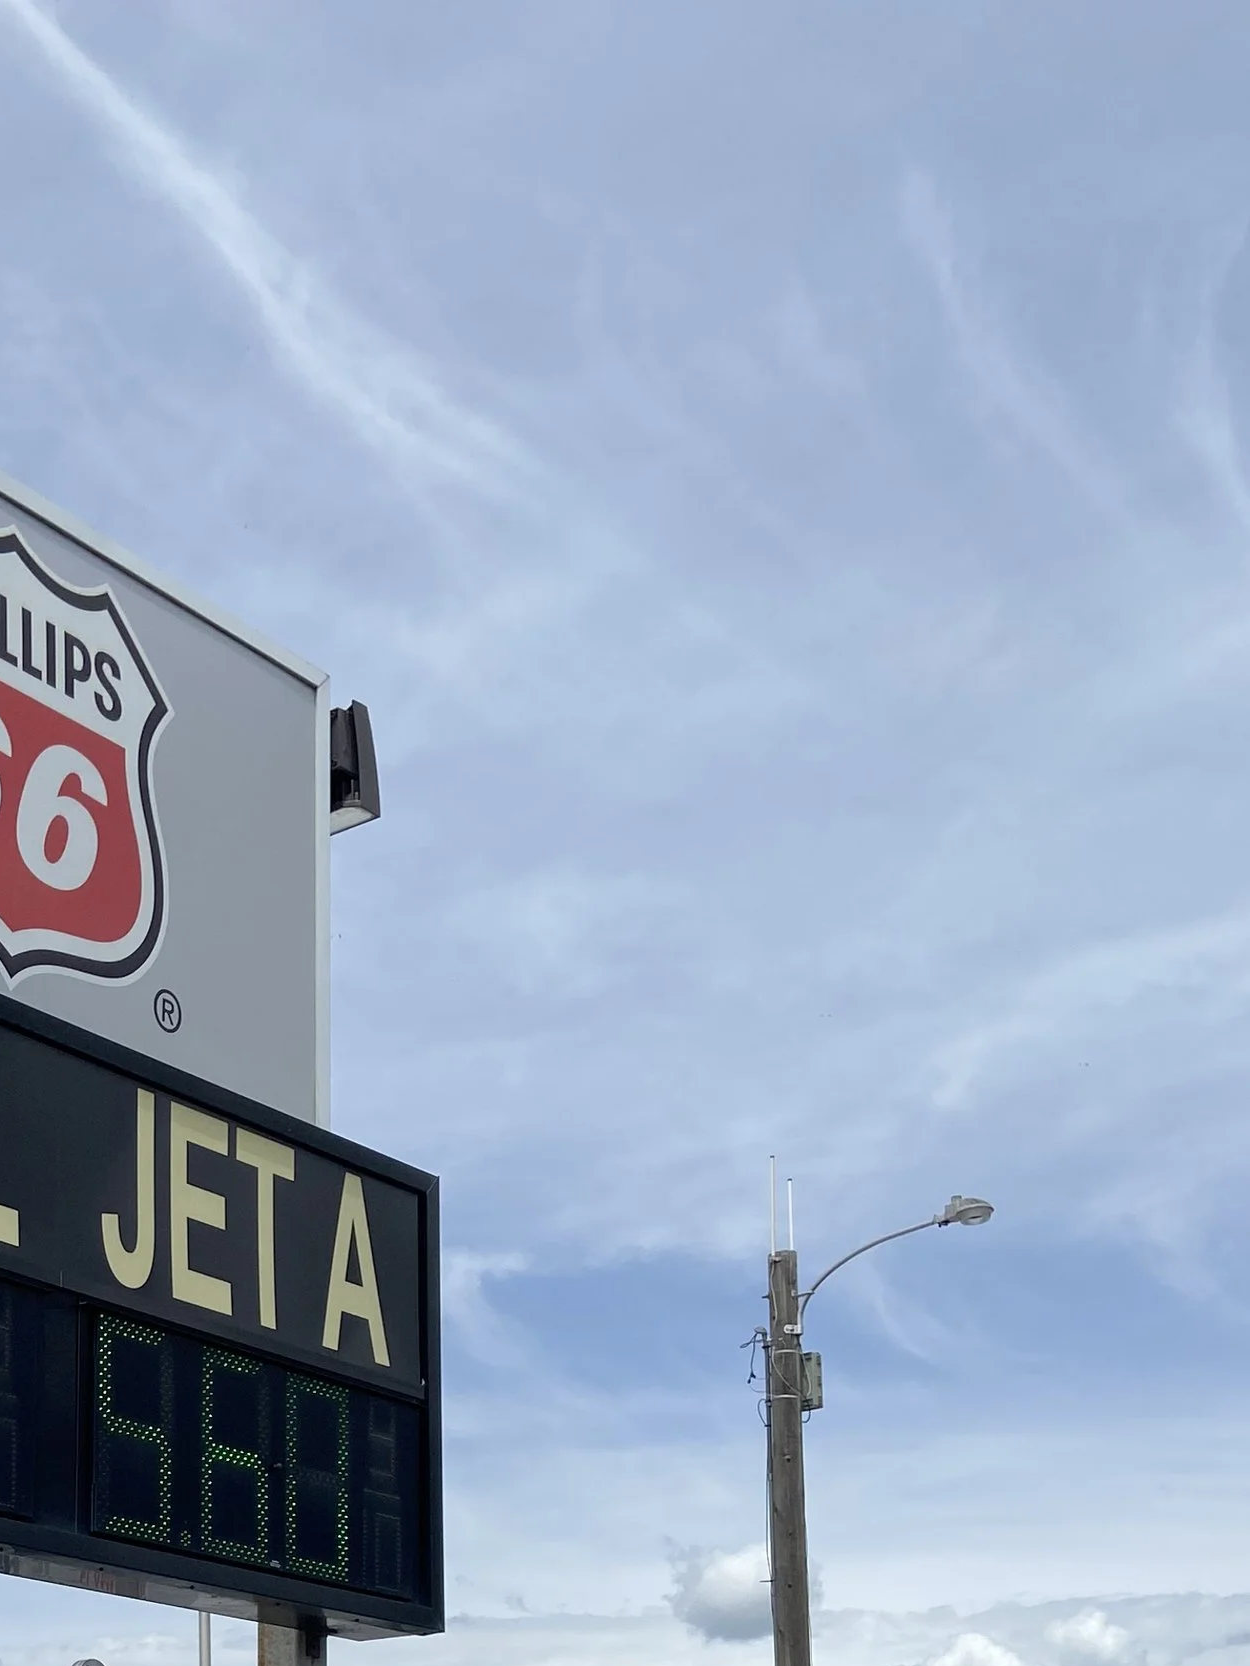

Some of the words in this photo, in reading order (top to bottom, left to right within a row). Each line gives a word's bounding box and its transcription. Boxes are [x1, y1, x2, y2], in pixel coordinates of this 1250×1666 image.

[101, 1088, 295, 1330] JET
[321, 1170, 391, 1367] A
[97, 1311, 351, 1583] 5.60
